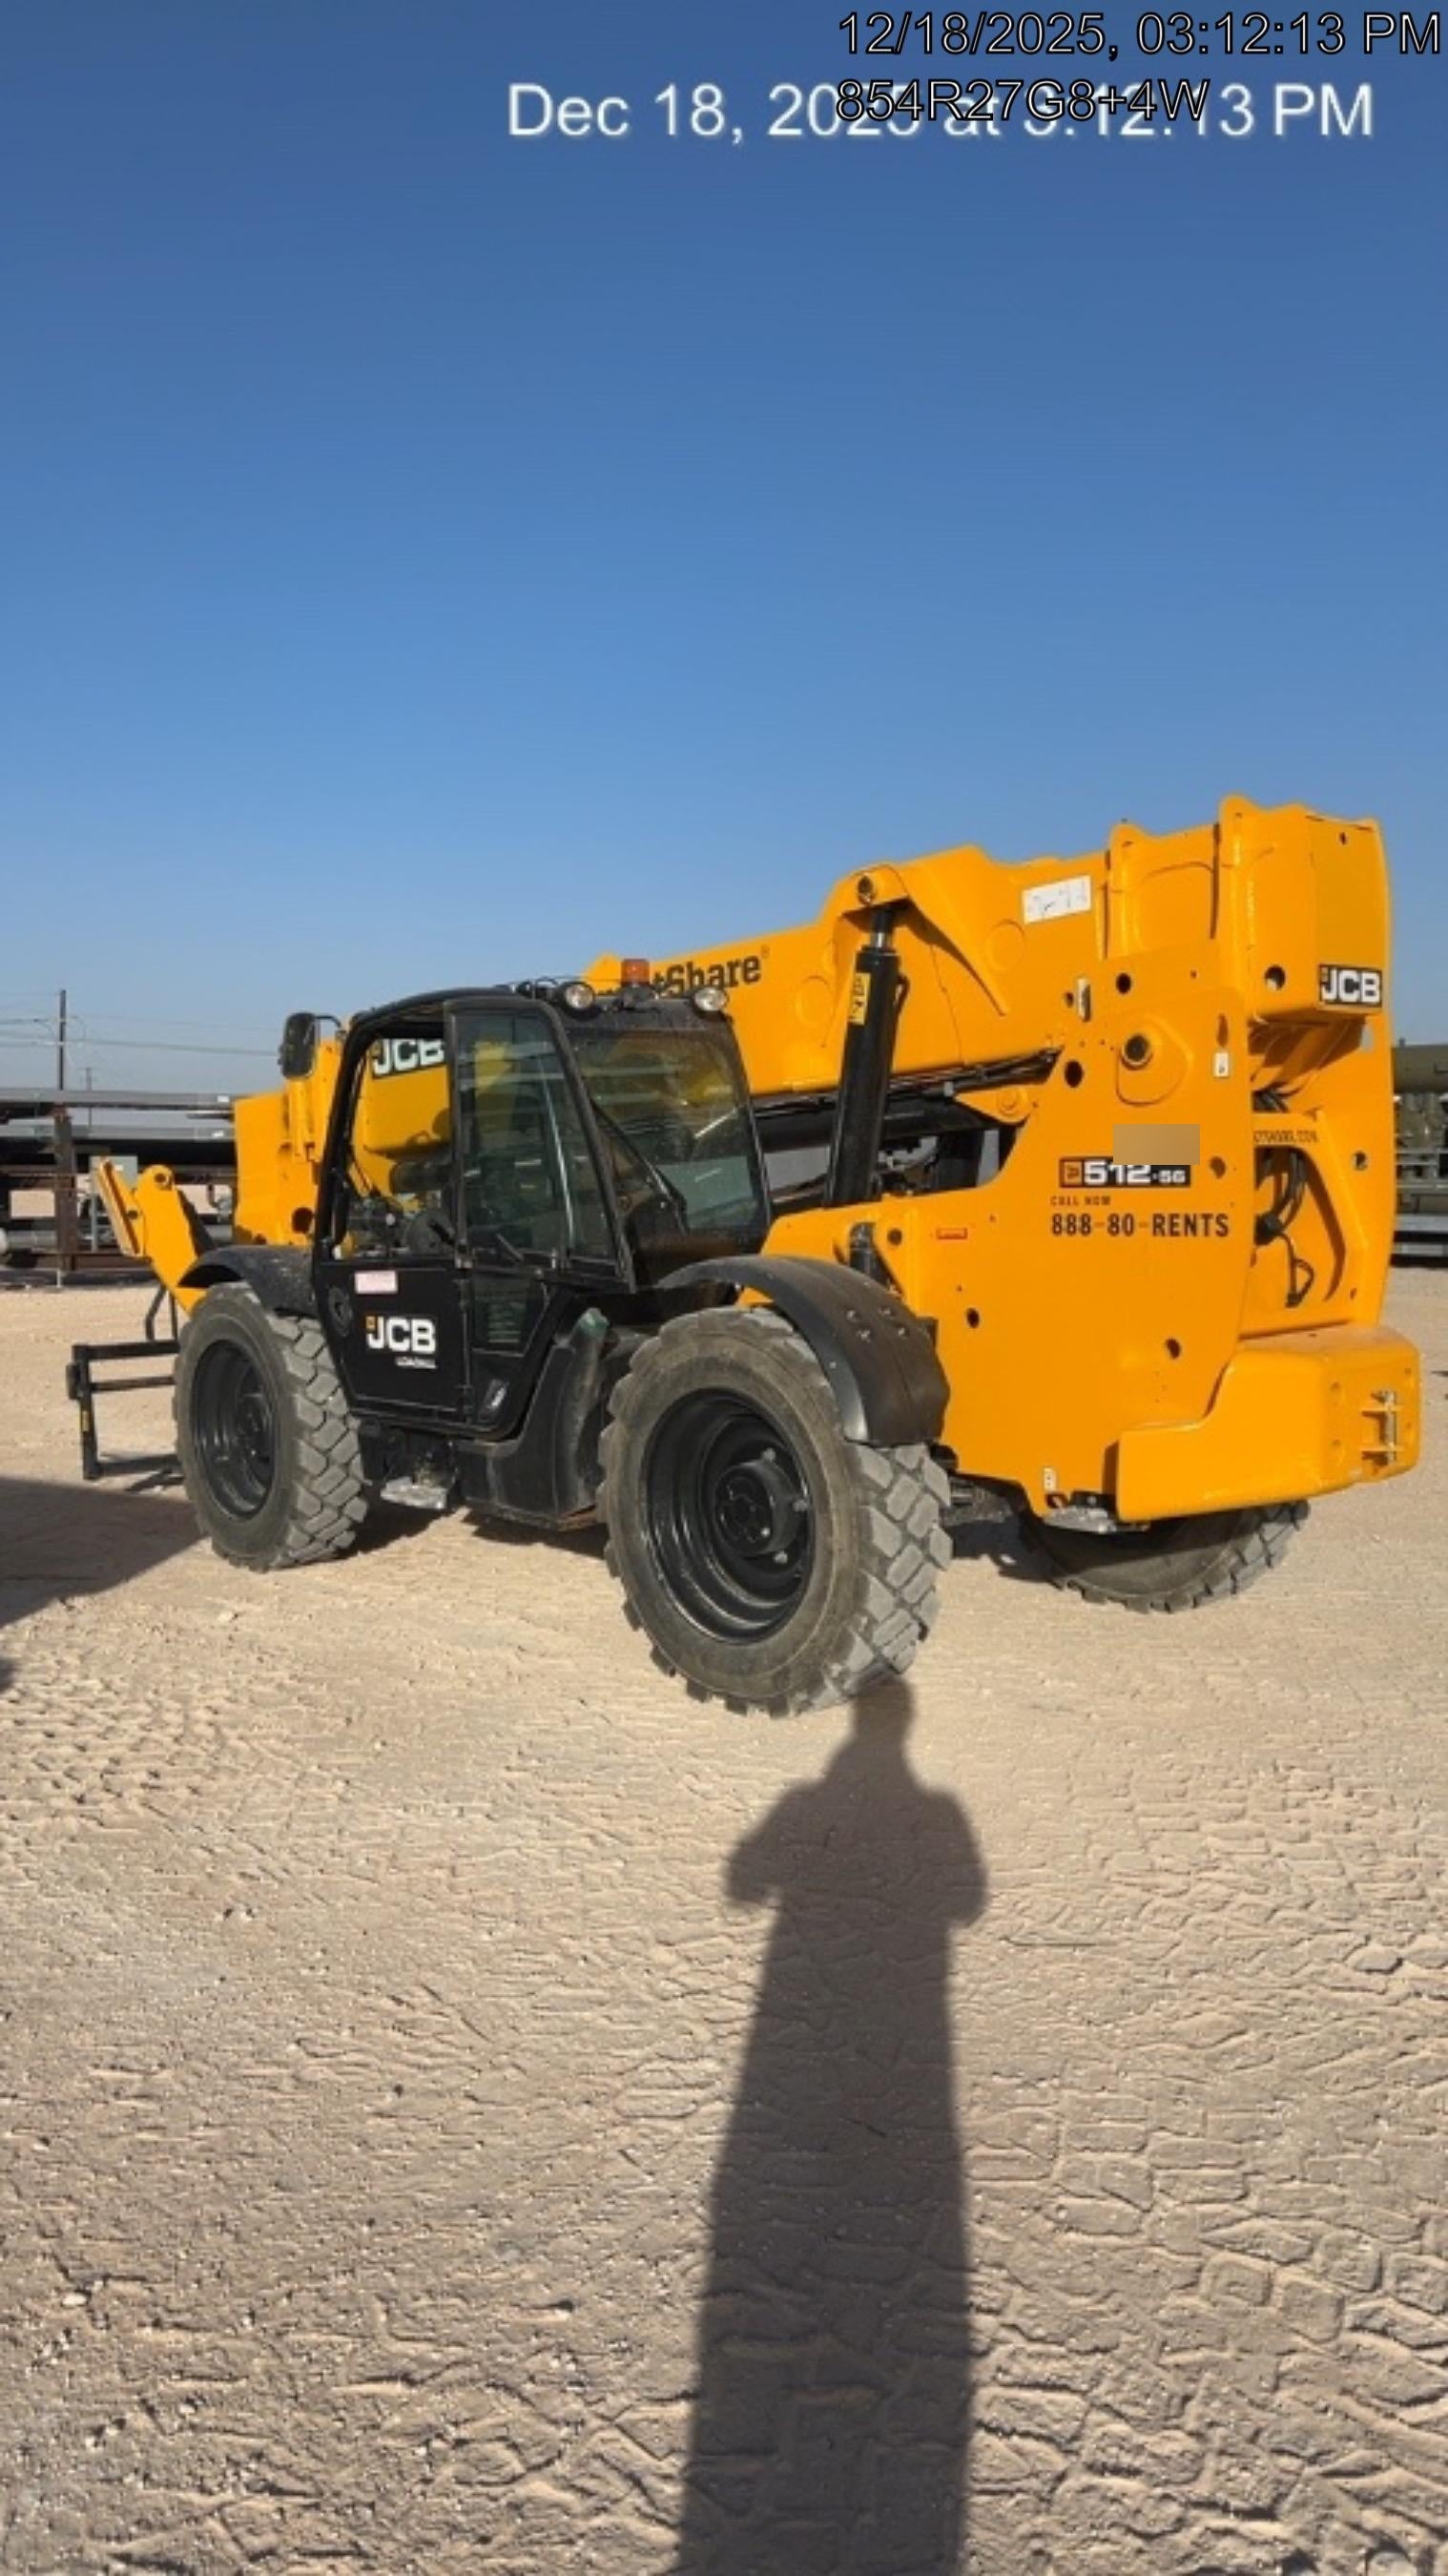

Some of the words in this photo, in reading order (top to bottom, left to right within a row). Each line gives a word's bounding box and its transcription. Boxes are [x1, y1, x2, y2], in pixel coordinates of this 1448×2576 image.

[1321, 968, 1380, 1002] JCB
[373, 1038, 445, 1075] JCB
[1051, 1213, 1230, 1237] 888-80-RENTS
[366, 1316, 436, 1353] JCB
